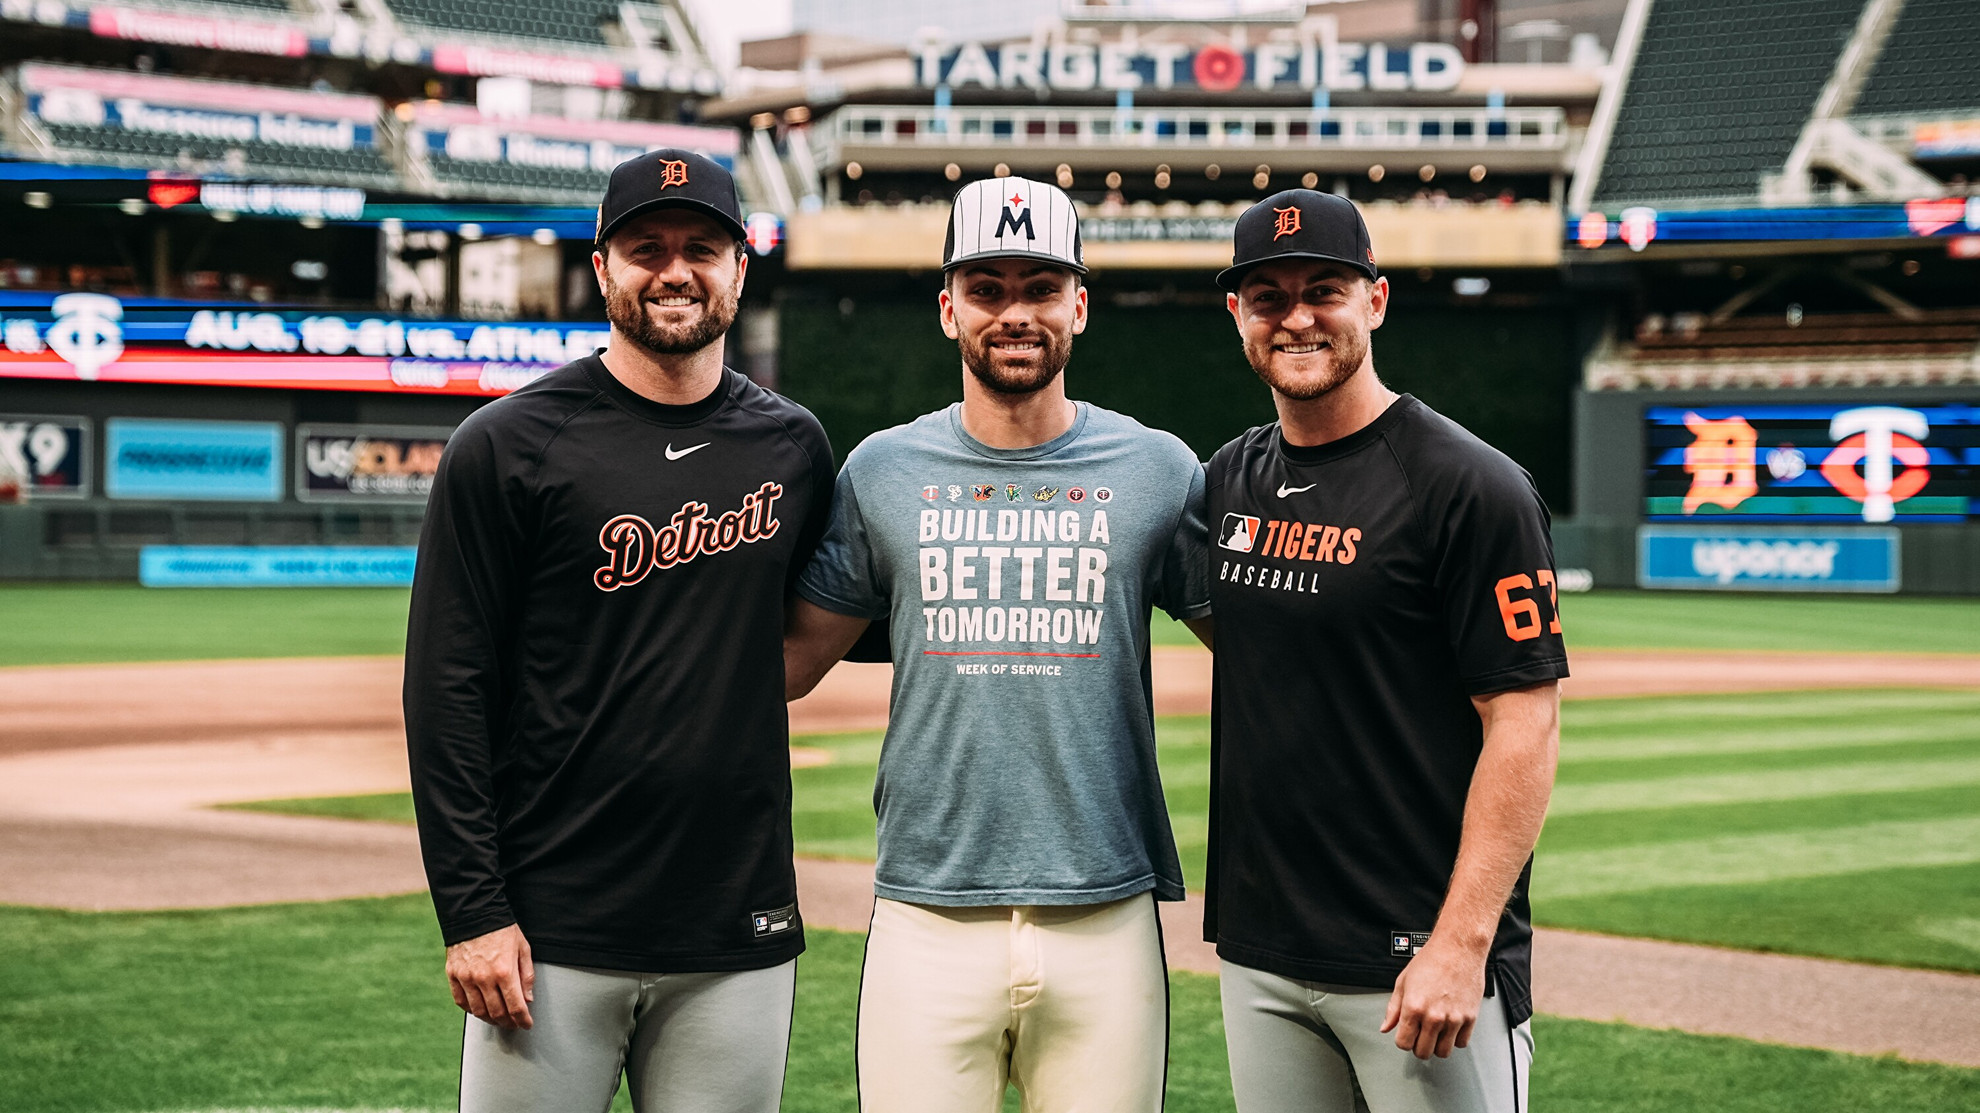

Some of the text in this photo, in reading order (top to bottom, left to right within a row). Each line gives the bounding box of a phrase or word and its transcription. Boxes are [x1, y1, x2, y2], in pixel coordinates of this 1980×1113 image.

[912, 42, 1466, 91] TARGET FIELD
[994, 205, 1036, 241] M
[594, 481, 783, 592] Detroit
[919, 509, 1110, 544] BUILDING A
[1260, 520, 1363, 565] TIGERS
[919, 546, 1108, 603] BETTER
[1219, 560, 1320, 594] BASEBALL
[922, 606, 1104, 645] TOMORROW
[956, 664, 1062, 676] WEEK OF SERVICE
